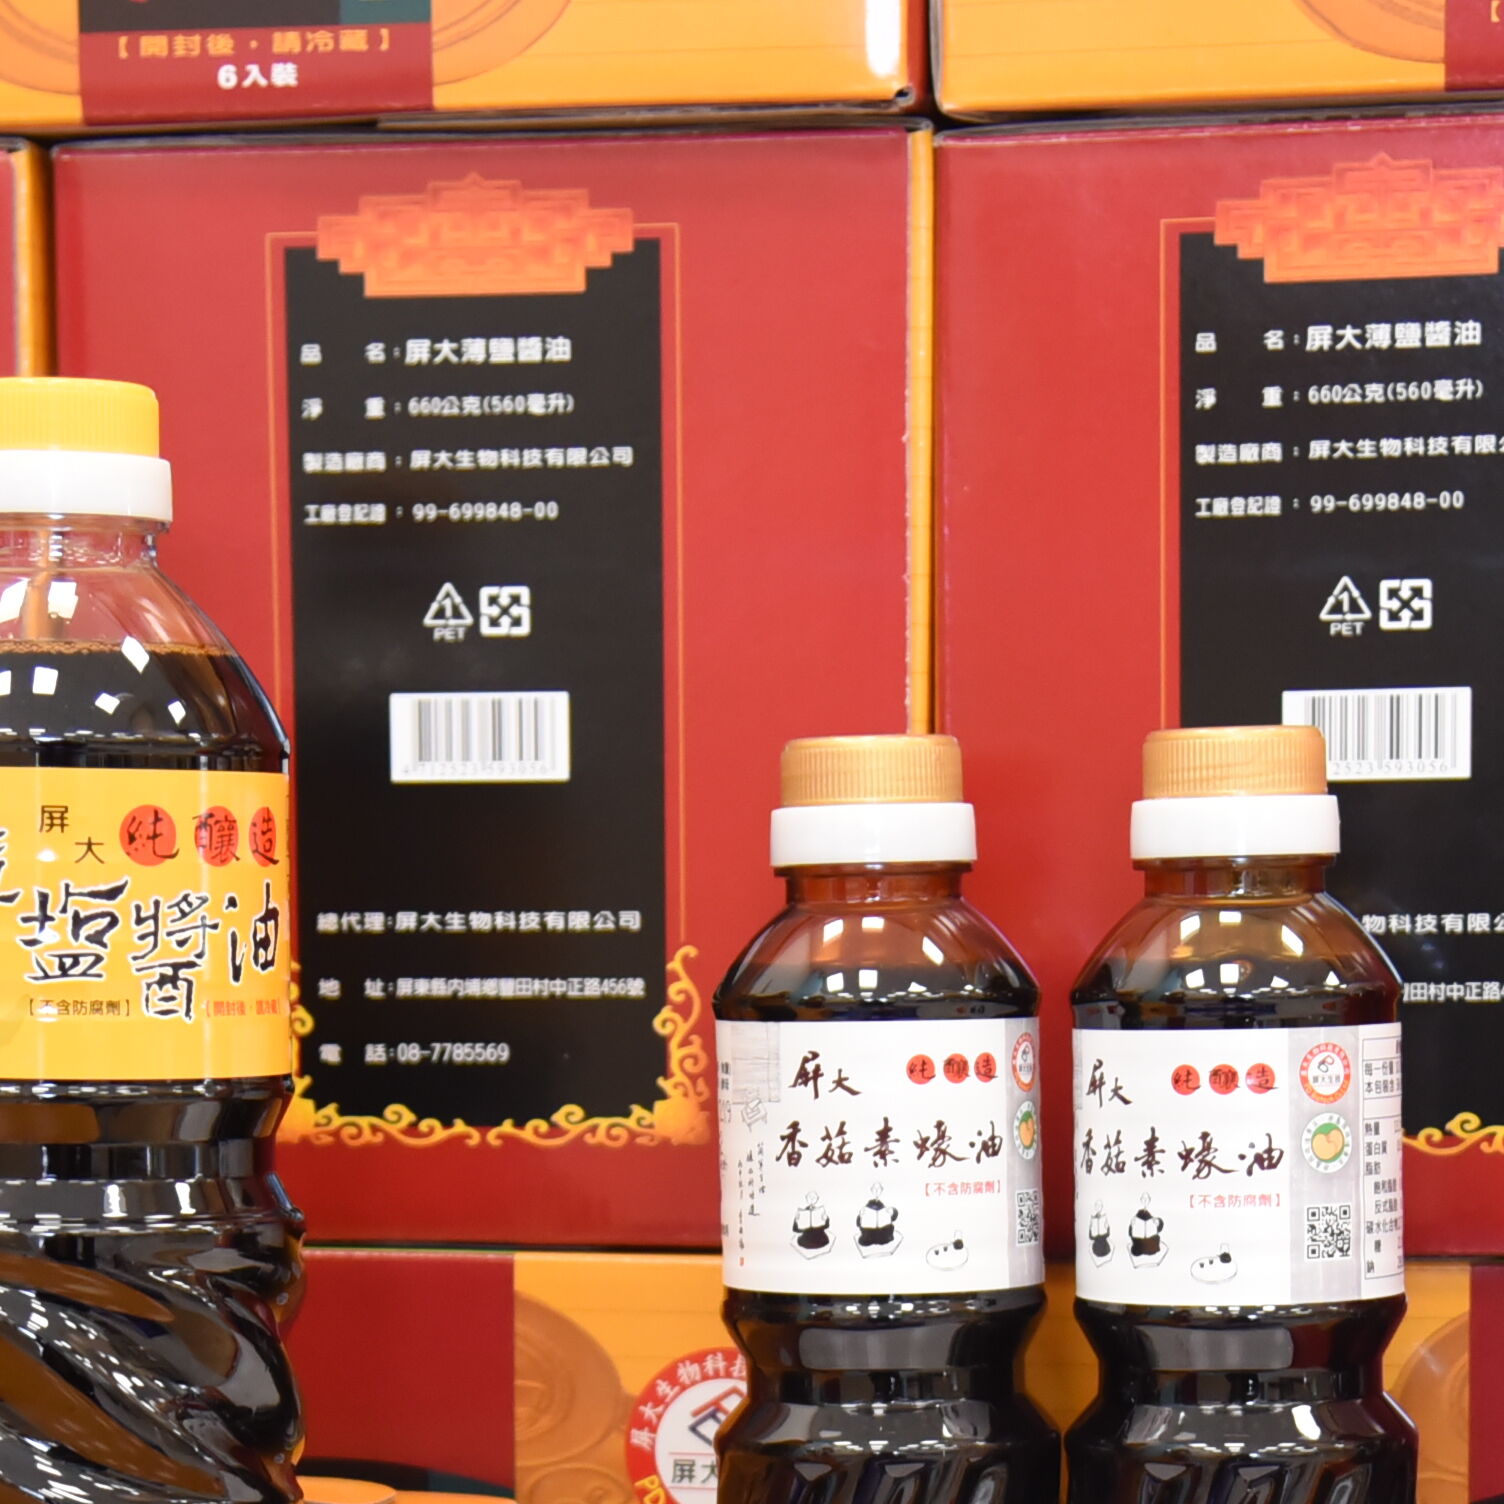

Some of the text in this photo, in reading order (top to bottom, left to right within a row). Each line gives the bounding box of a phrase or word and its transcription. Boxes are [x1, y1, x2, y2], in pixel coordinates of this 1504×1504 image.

[216, 62, 299, 89] 6入裝
[433, 627, 466, 642] PET
[1330, 621, 1364, 636] PET
